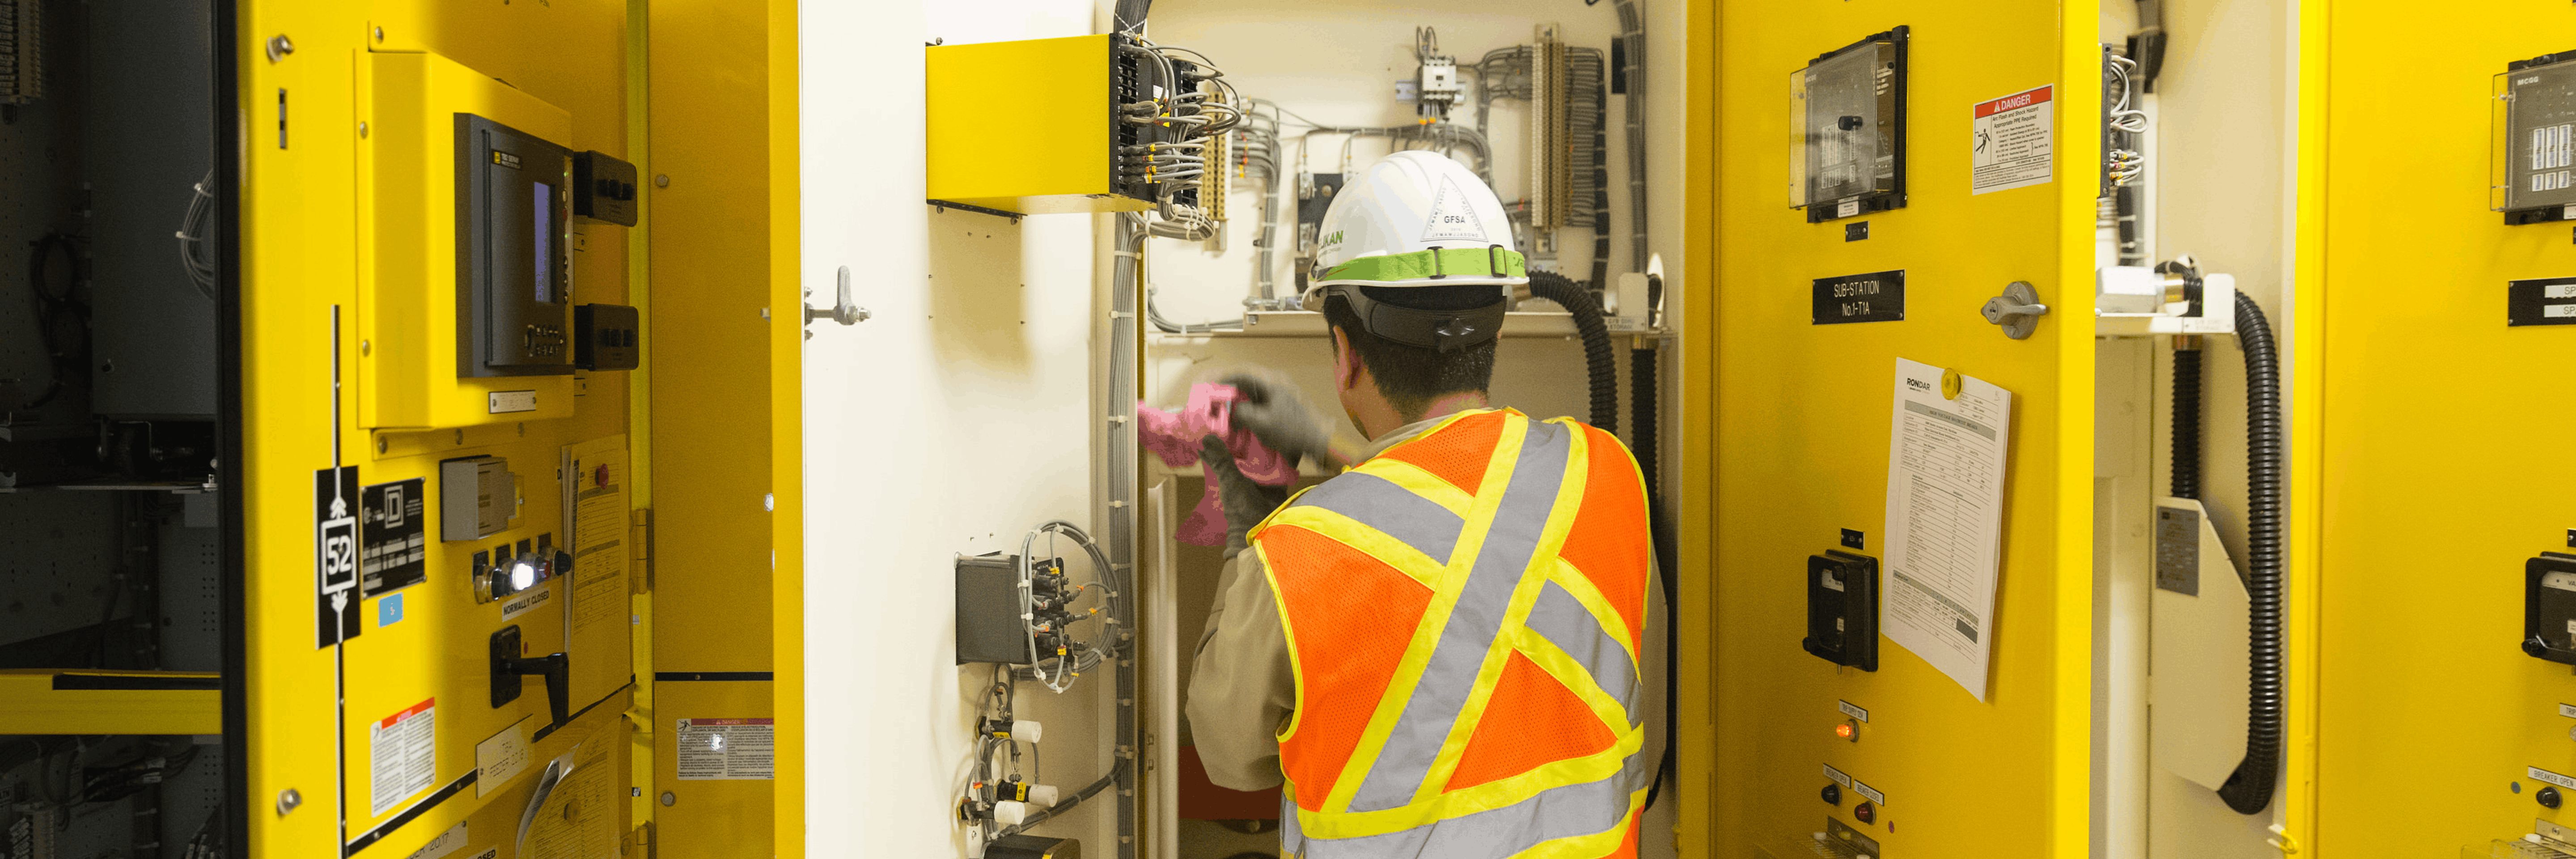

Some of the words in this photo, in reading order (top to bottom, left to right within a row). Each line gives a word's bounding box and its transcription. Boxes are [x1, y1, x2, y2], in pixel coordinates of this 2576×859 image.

[2517, 76, 2539, 85] MCGG
[2001, 94, 2031, 110] DANGER
[1994, 119, 2013, 128] Appropriate
[2021, 115, 2037, 123] Required
[1998, 112, 2007, 120] Flash
[1444, 216, 1466, 224] GFSA
[1834, 280, 1879, 298] SUB-STATION
[2564, 286, 2576, 295] SP
[1842, 301, 1870, 317] No.1-T1A
[1907, 378, 1930, 391] RONDAR
[326, 535, 352, 575] 52
[503, 597, 530, 616] NORMALLY
[531, 590, 550, 604] CLOSED
[2534, 770, 2558, 782] BREAKER
[2559, 777, 2573, 787] OPEN
